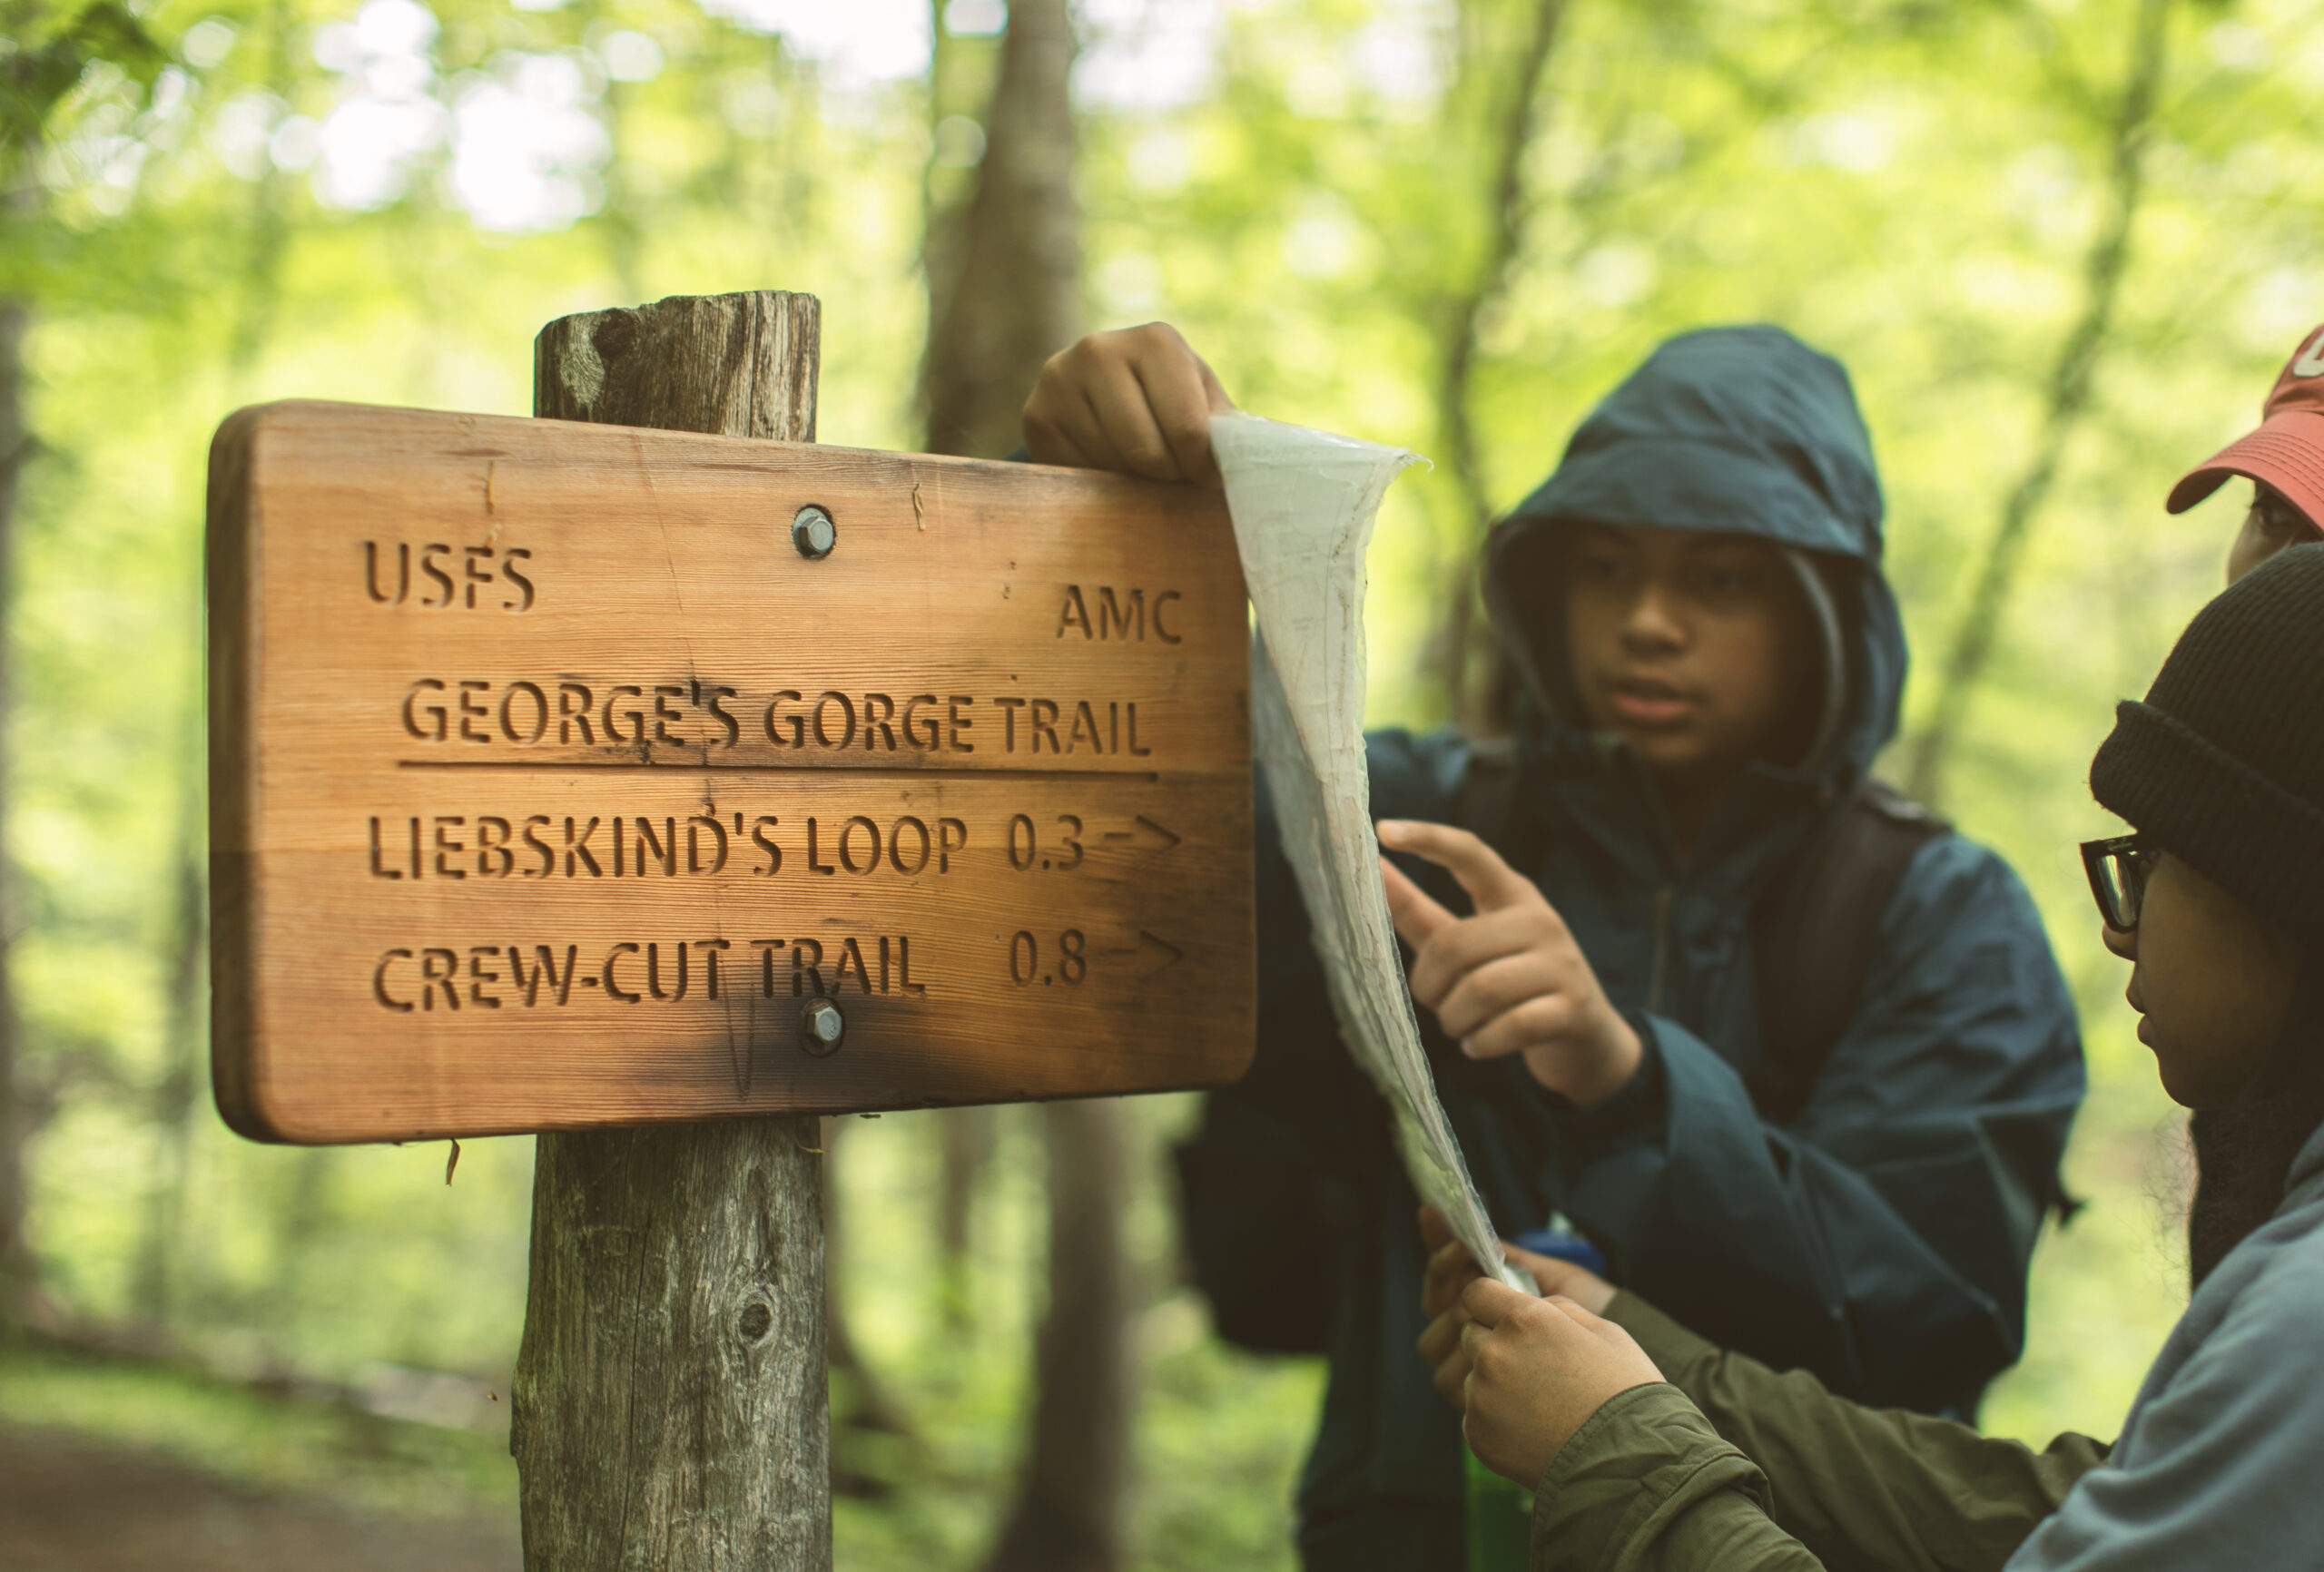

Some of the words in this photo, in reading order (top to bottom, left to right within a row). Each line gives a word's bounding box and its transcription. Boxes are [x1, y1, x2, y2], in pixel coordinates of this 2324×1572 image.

[366, 541, 536, 612] USFS
[1057, 585, 1183, 645] AMC
[402, 677, 741, 750] GEORGE'S
[763, 690, 974, 753] GORGE
[993, 697, 1152, 757] TRAIL
[369, 811, 783, 879] LIEBSKIND'S
[807, 815, 968, 877] LOOP
[1008, 813, 1085, 872] 0.3
[372, 938, 731, 1014] CREW-CUT
[750, 936, 926, 997] TRAIL
[1009, 928, 1088, 988] 0.8
